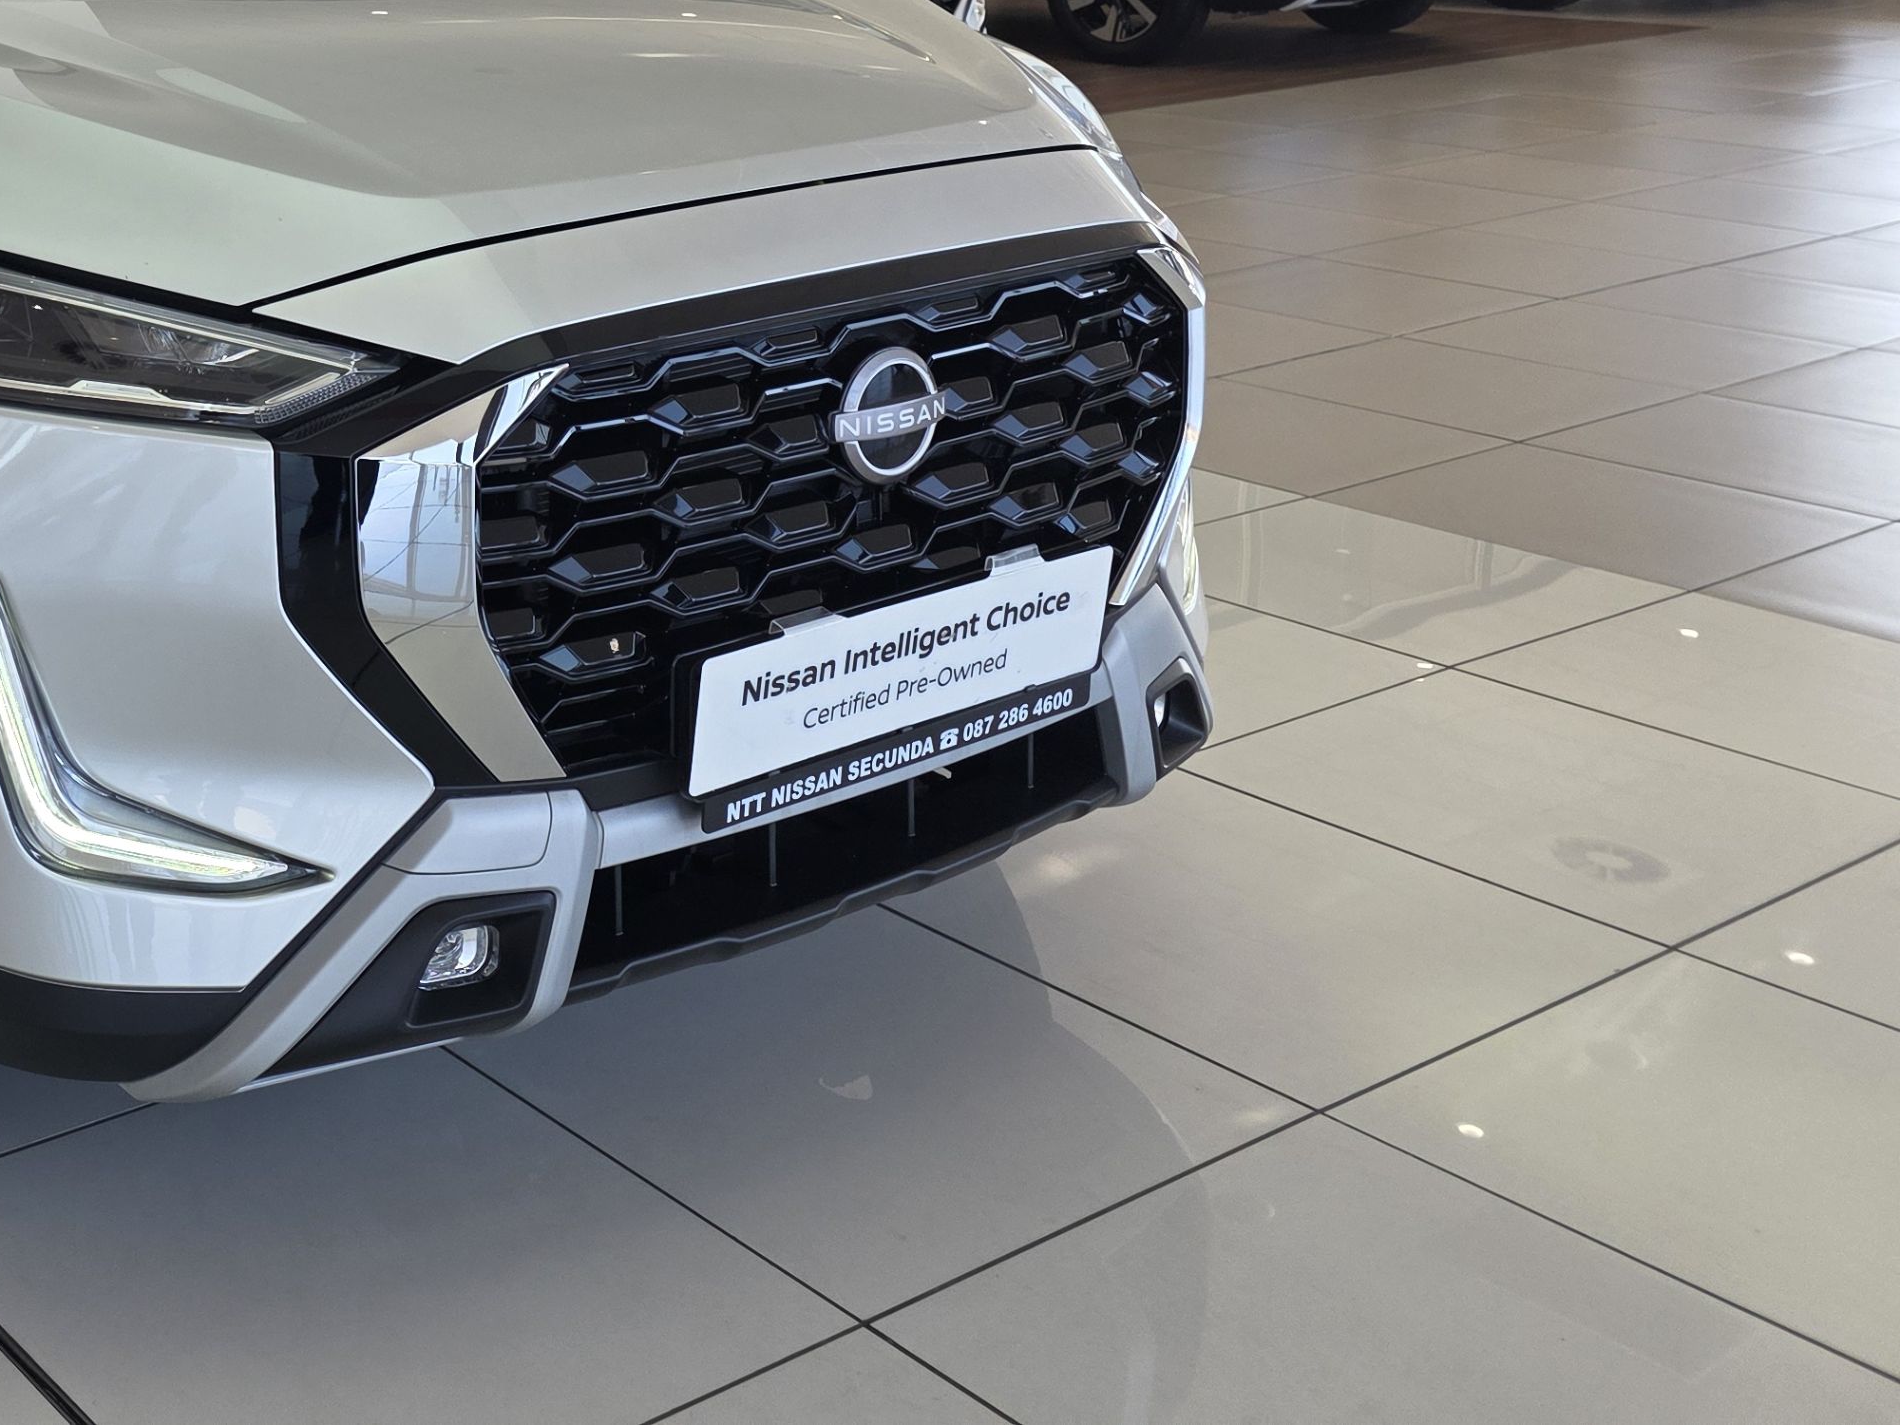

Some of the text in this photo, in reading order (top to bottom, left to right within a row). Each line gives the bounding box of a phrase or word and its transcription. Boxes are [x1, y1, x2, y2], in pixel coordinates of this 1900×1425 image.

[839, 396, 946, 438] NISSAN
[741, 591, 1071, 707] Nissan Intelligent Choice
[803, 648, 1008, 729] Certified Pre-Owned
[726, 688, 1073, 824] NTT NISSAN SECUNDA 087 286 4600
